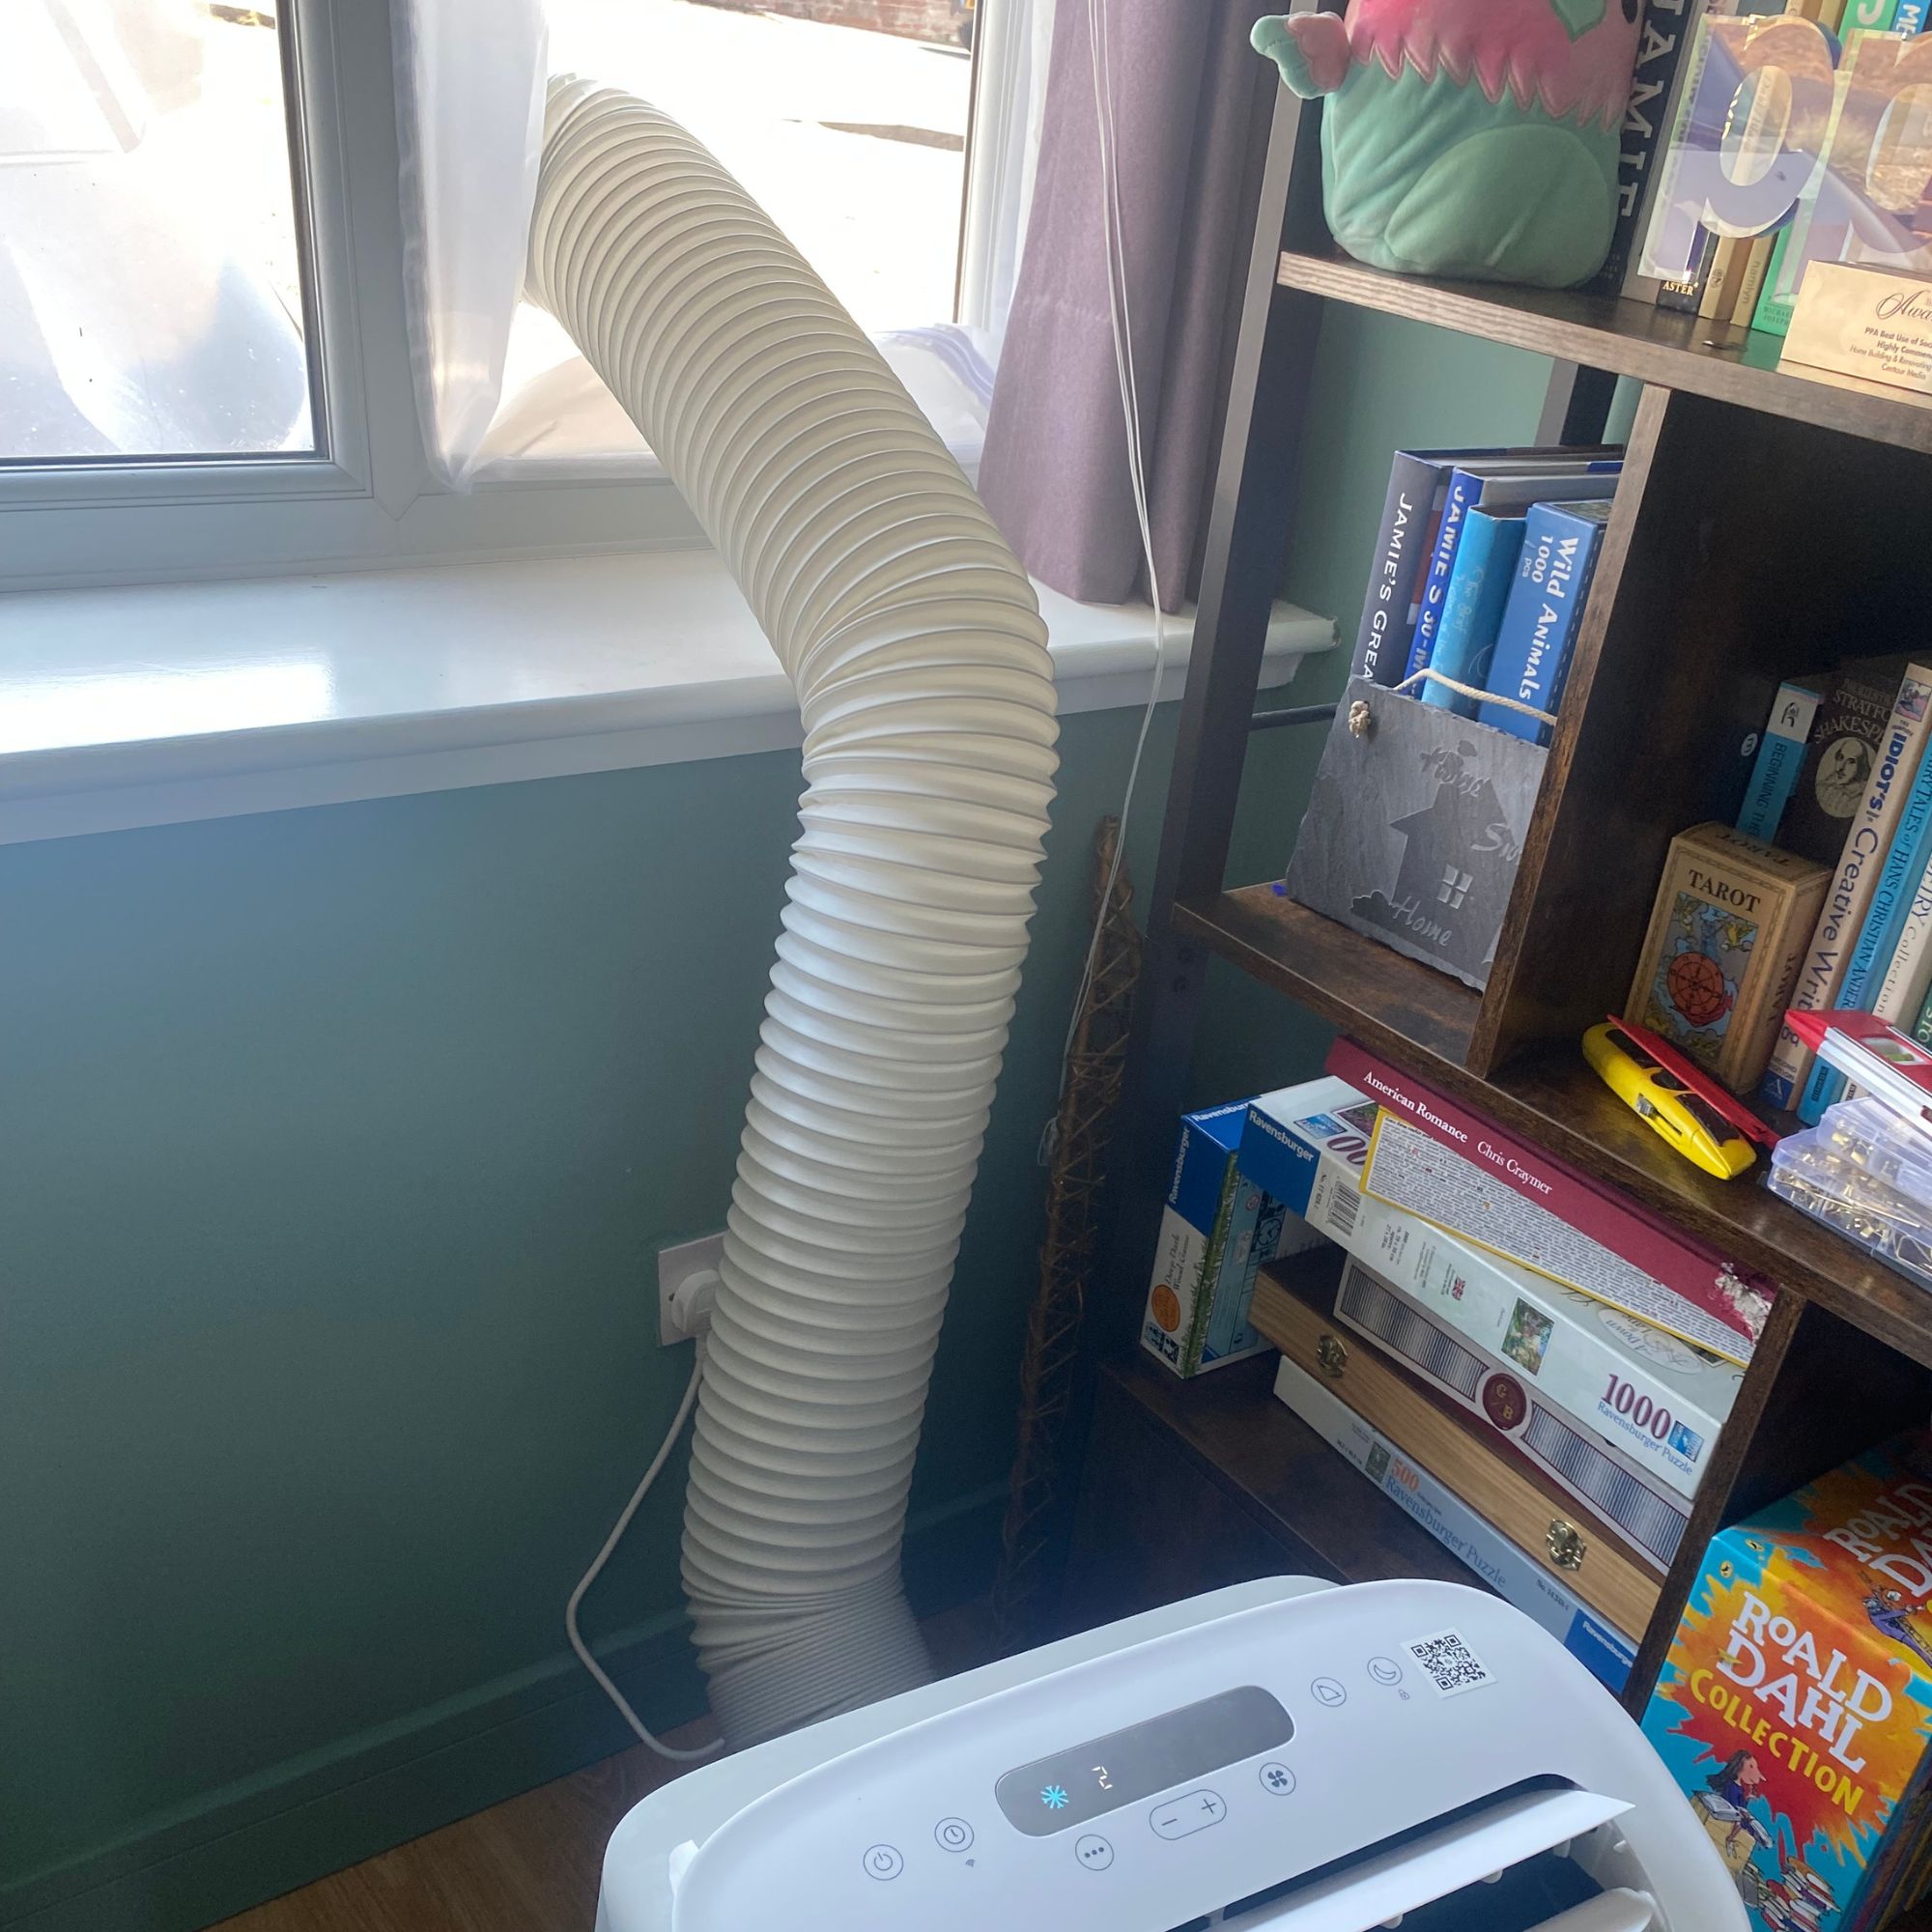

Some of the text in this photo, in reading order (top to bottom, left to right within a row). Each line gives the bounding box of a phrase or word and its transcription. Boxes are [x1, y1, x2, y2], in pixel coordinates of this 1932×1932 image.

[1662, 281, 1693, 297] ASTER
[1850, 345, 1867, 356] Home
[1864, 327, 1879, 337] PPA
[1880, 329, 1894, 339] Best
[1896, 333, 1909, 344] Use
[1911, 334, 1919, 345] of
[1877, 340, 1899, 354] Highly
[1379, 493, 1412, 602] JAMIE'S
[1429, 486, 1463, 605] JAMIES
[1522, 556, 1532, 579] pcs
[1532, 535, 1554, 584] 1000
[1547, 537, 1578, 599] Wild
[1754, 742, 1786, 810] BEGINNING
[1869, 732, 1907, 811] IDIOT'S
[1905, 788, 1929, 833] TALES
[1688, 868, 1761, 914] TAROT
[1822, 827, 1879, 943] Creative
[1889, 849, 1909, 890] HANS
[1390, 895, 1453, 948] Home
[1859, 889, 1895, 963] CHRISTIAN
[1877, 925, 1918, 1013] Collection
[1168, 1125, 1191, 1204] Ravensburger
[1249, 1110, 1315, 1163] Ravensburger
[1364, 1071, 1553, 1196] American Romance Chris Craymer
[1597, 1401, 1693, 1476] Ravensburger Puzzle
[1601, 1373, 1672, 1439] 1000
[1391, 1458, 1421, 1492] 500
[1385, 1476, 1468, 1549] Ravensburger
[1466, 1544, 1508, 1588] Puzzle
[1732, 1591, 1892, 1721] ROALD
[1716, 1628, 1866, 1774] DAHL
[1690, 1668, 1864, 1816] COLLECTION
